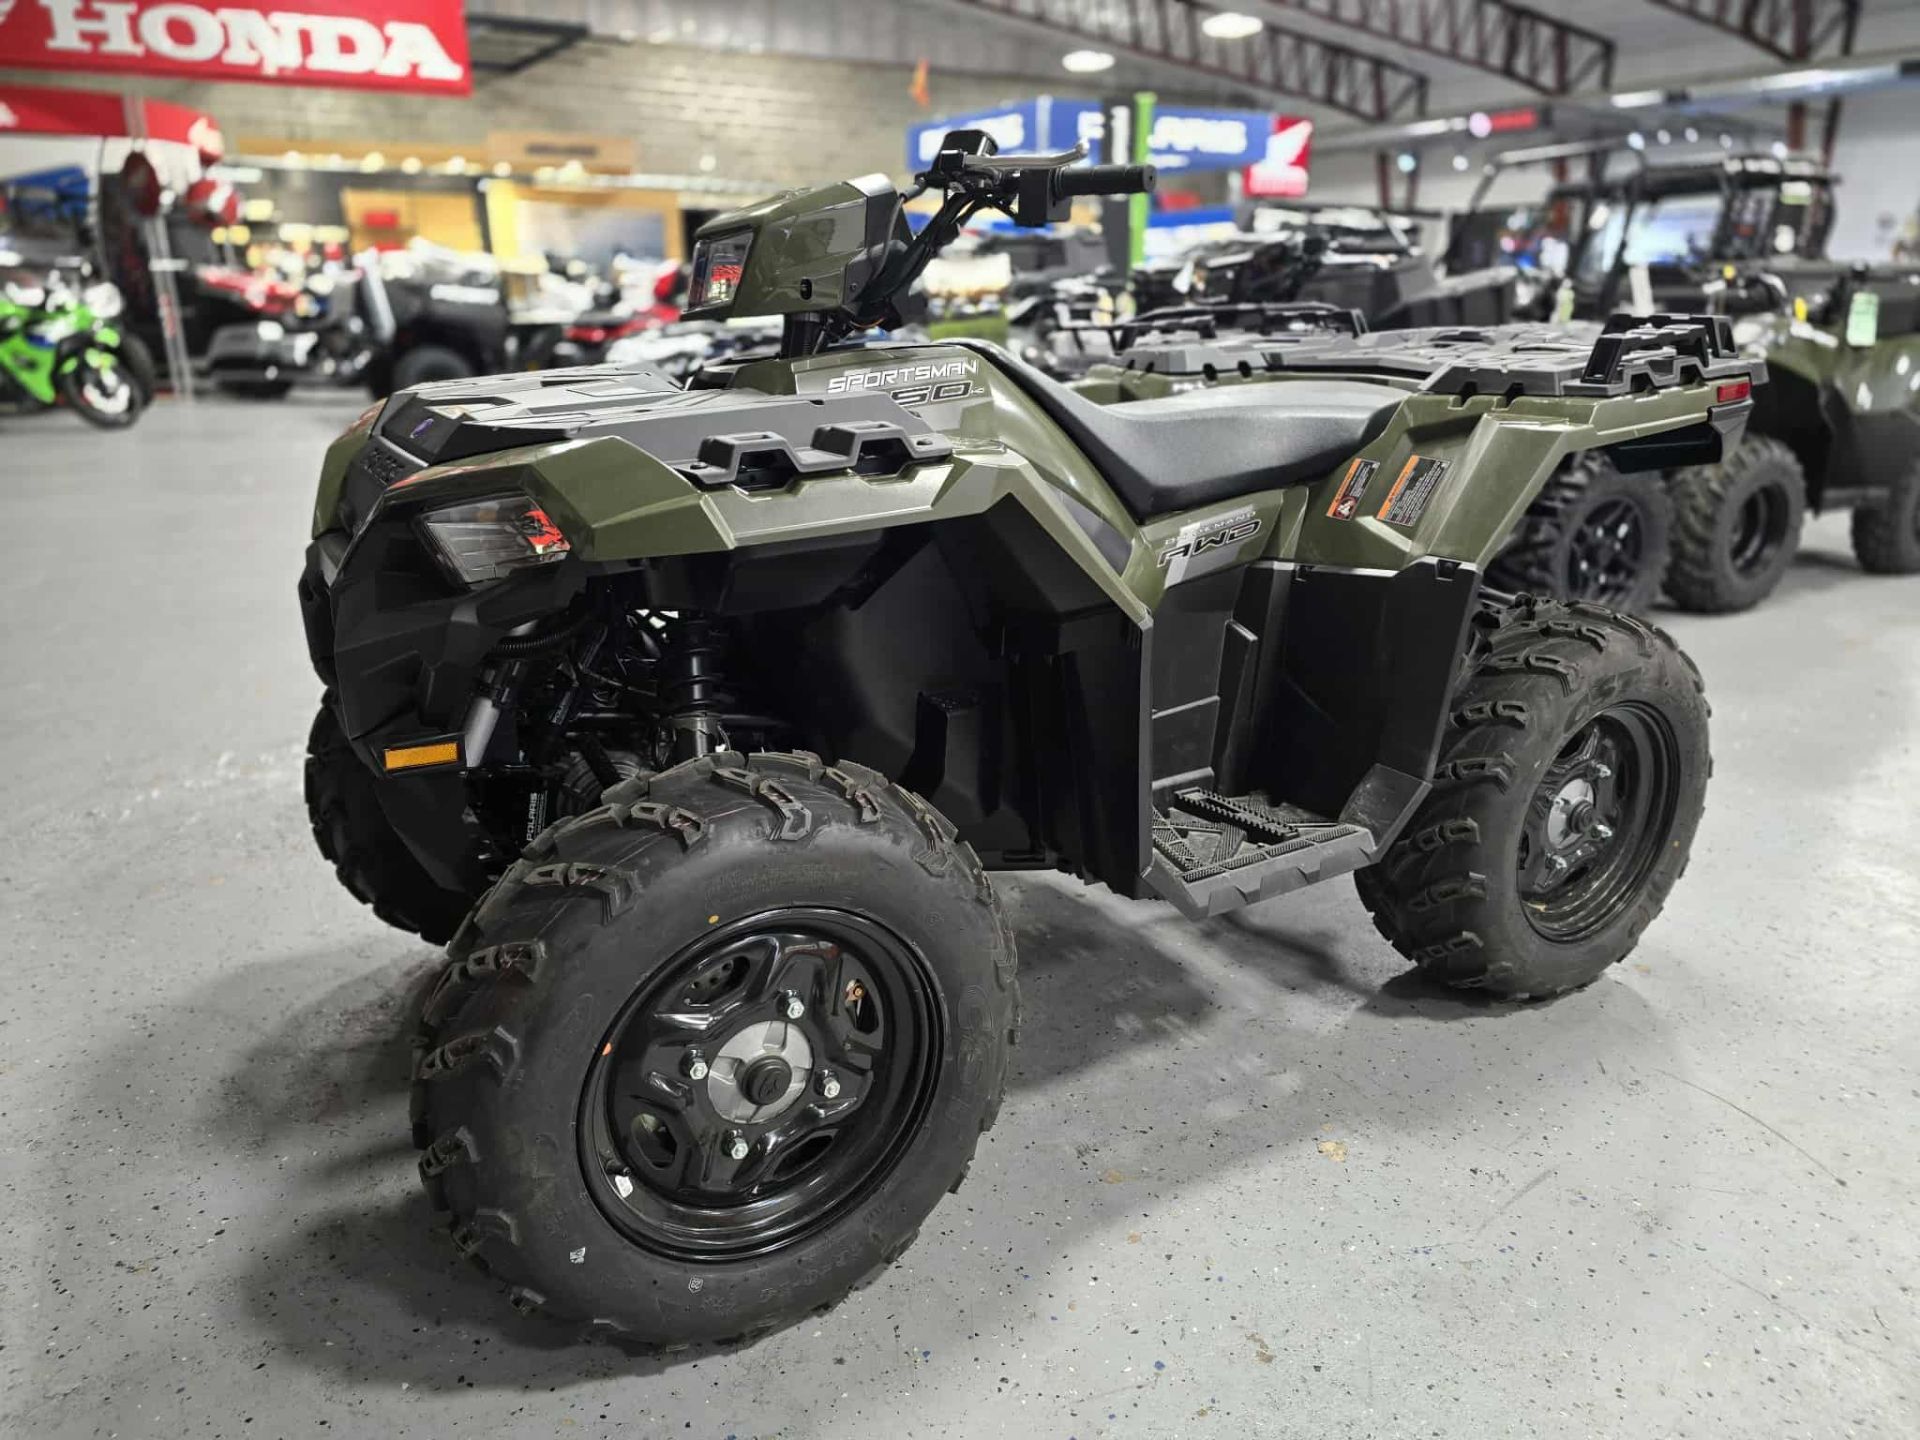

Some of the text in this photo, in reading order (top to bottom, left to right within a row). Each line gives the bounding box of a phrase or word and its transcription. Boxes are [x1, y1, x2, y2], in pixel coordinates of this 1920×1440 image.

[46, 0, 464, 80] HONDA
[827, 360, 978, 393] SPORTSMAN
[1156, 519, 1262, 568] AWD
[526, 792, 538, 841] POLARIS
